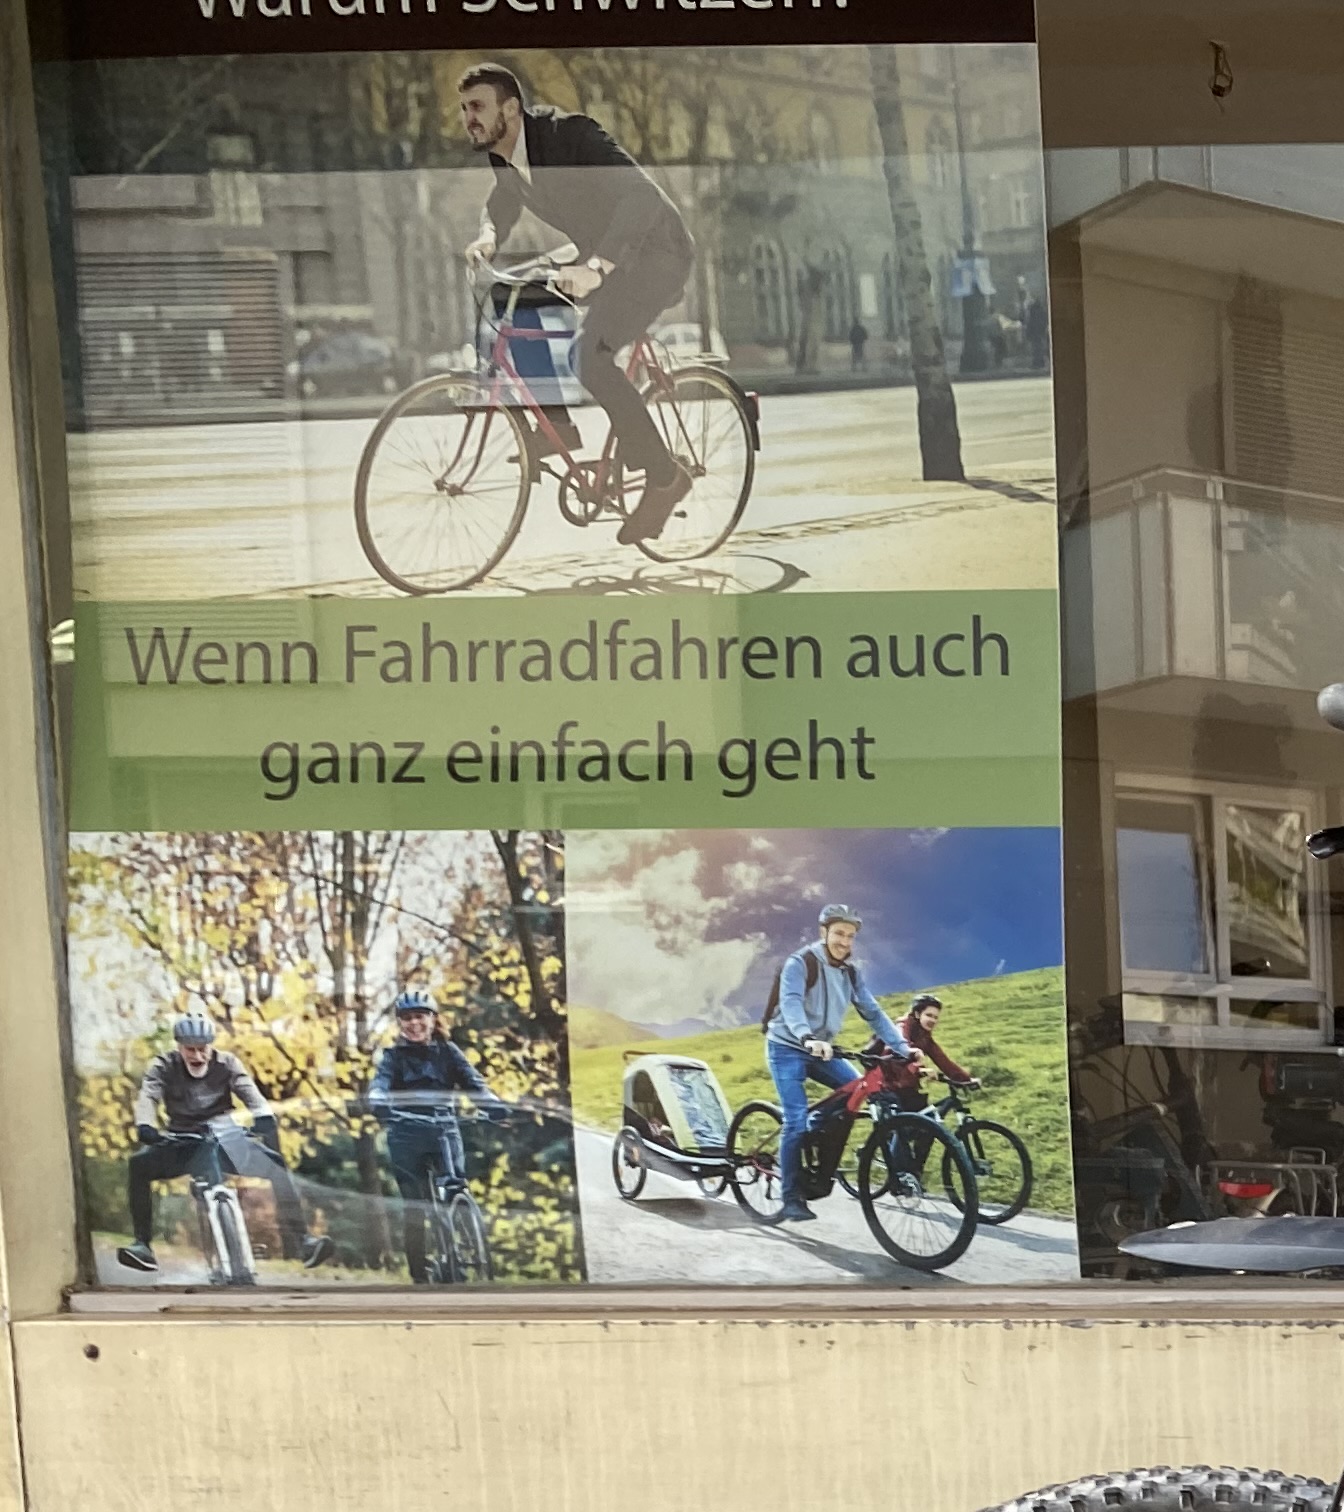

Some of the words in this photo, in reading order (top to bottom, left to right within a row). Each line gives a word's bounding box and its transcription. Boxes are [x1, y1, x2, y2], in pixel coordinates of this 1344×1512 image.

[124, 626, 318, 685] Wenn
[345, 618, 823, 684] Fahrradfahren
[846, 615, 1012, 679] auch
[259, 737, 426, 801] ganz
[446, 720, 695, 785] einfach
[717, 720, 877, 799] geht
